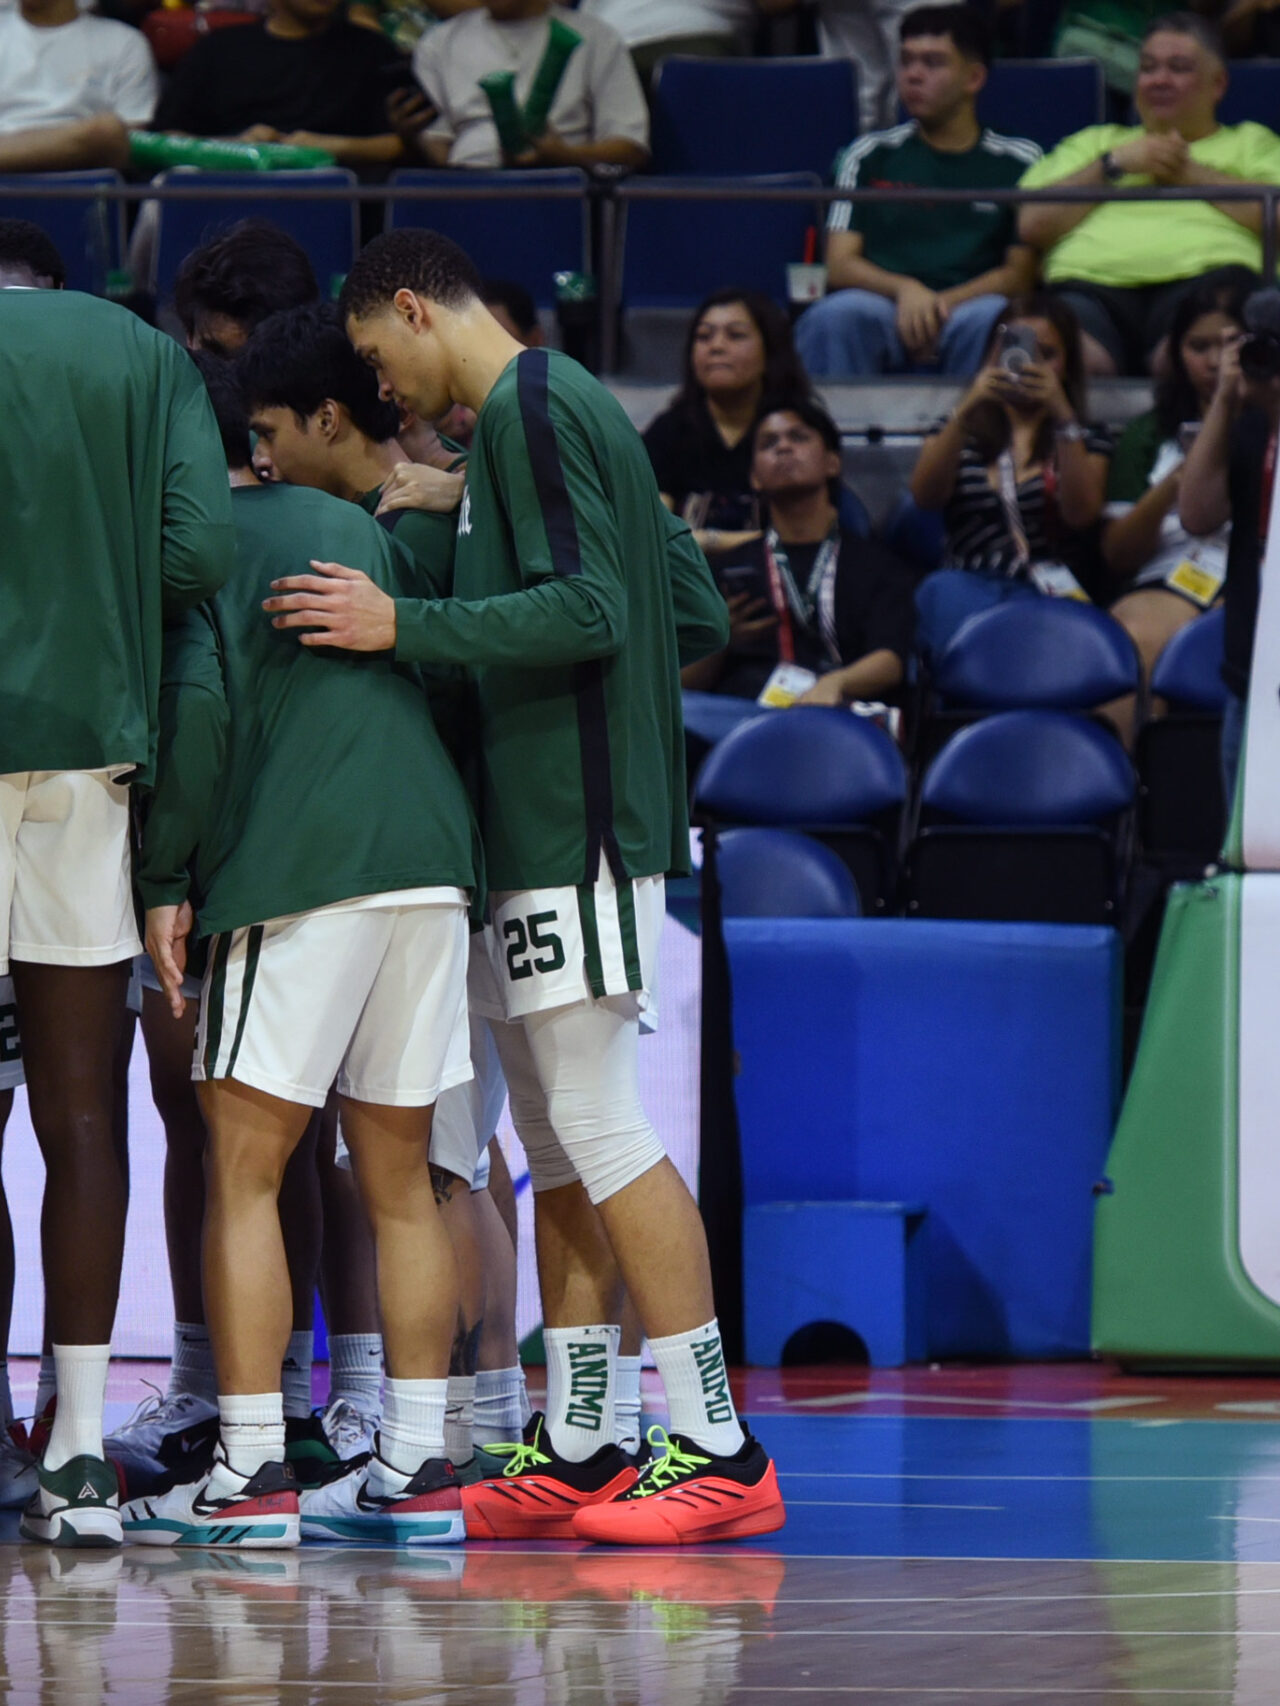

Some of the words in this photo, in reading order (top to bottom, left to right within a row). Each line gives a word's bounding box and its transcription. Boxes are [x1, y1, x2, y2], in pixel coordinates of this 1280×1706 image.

[503, 910, 566, 981] 25
[565, 1343, 608, 1431] ANIMO
[690, 1337, 733, 1424] ANIMO
